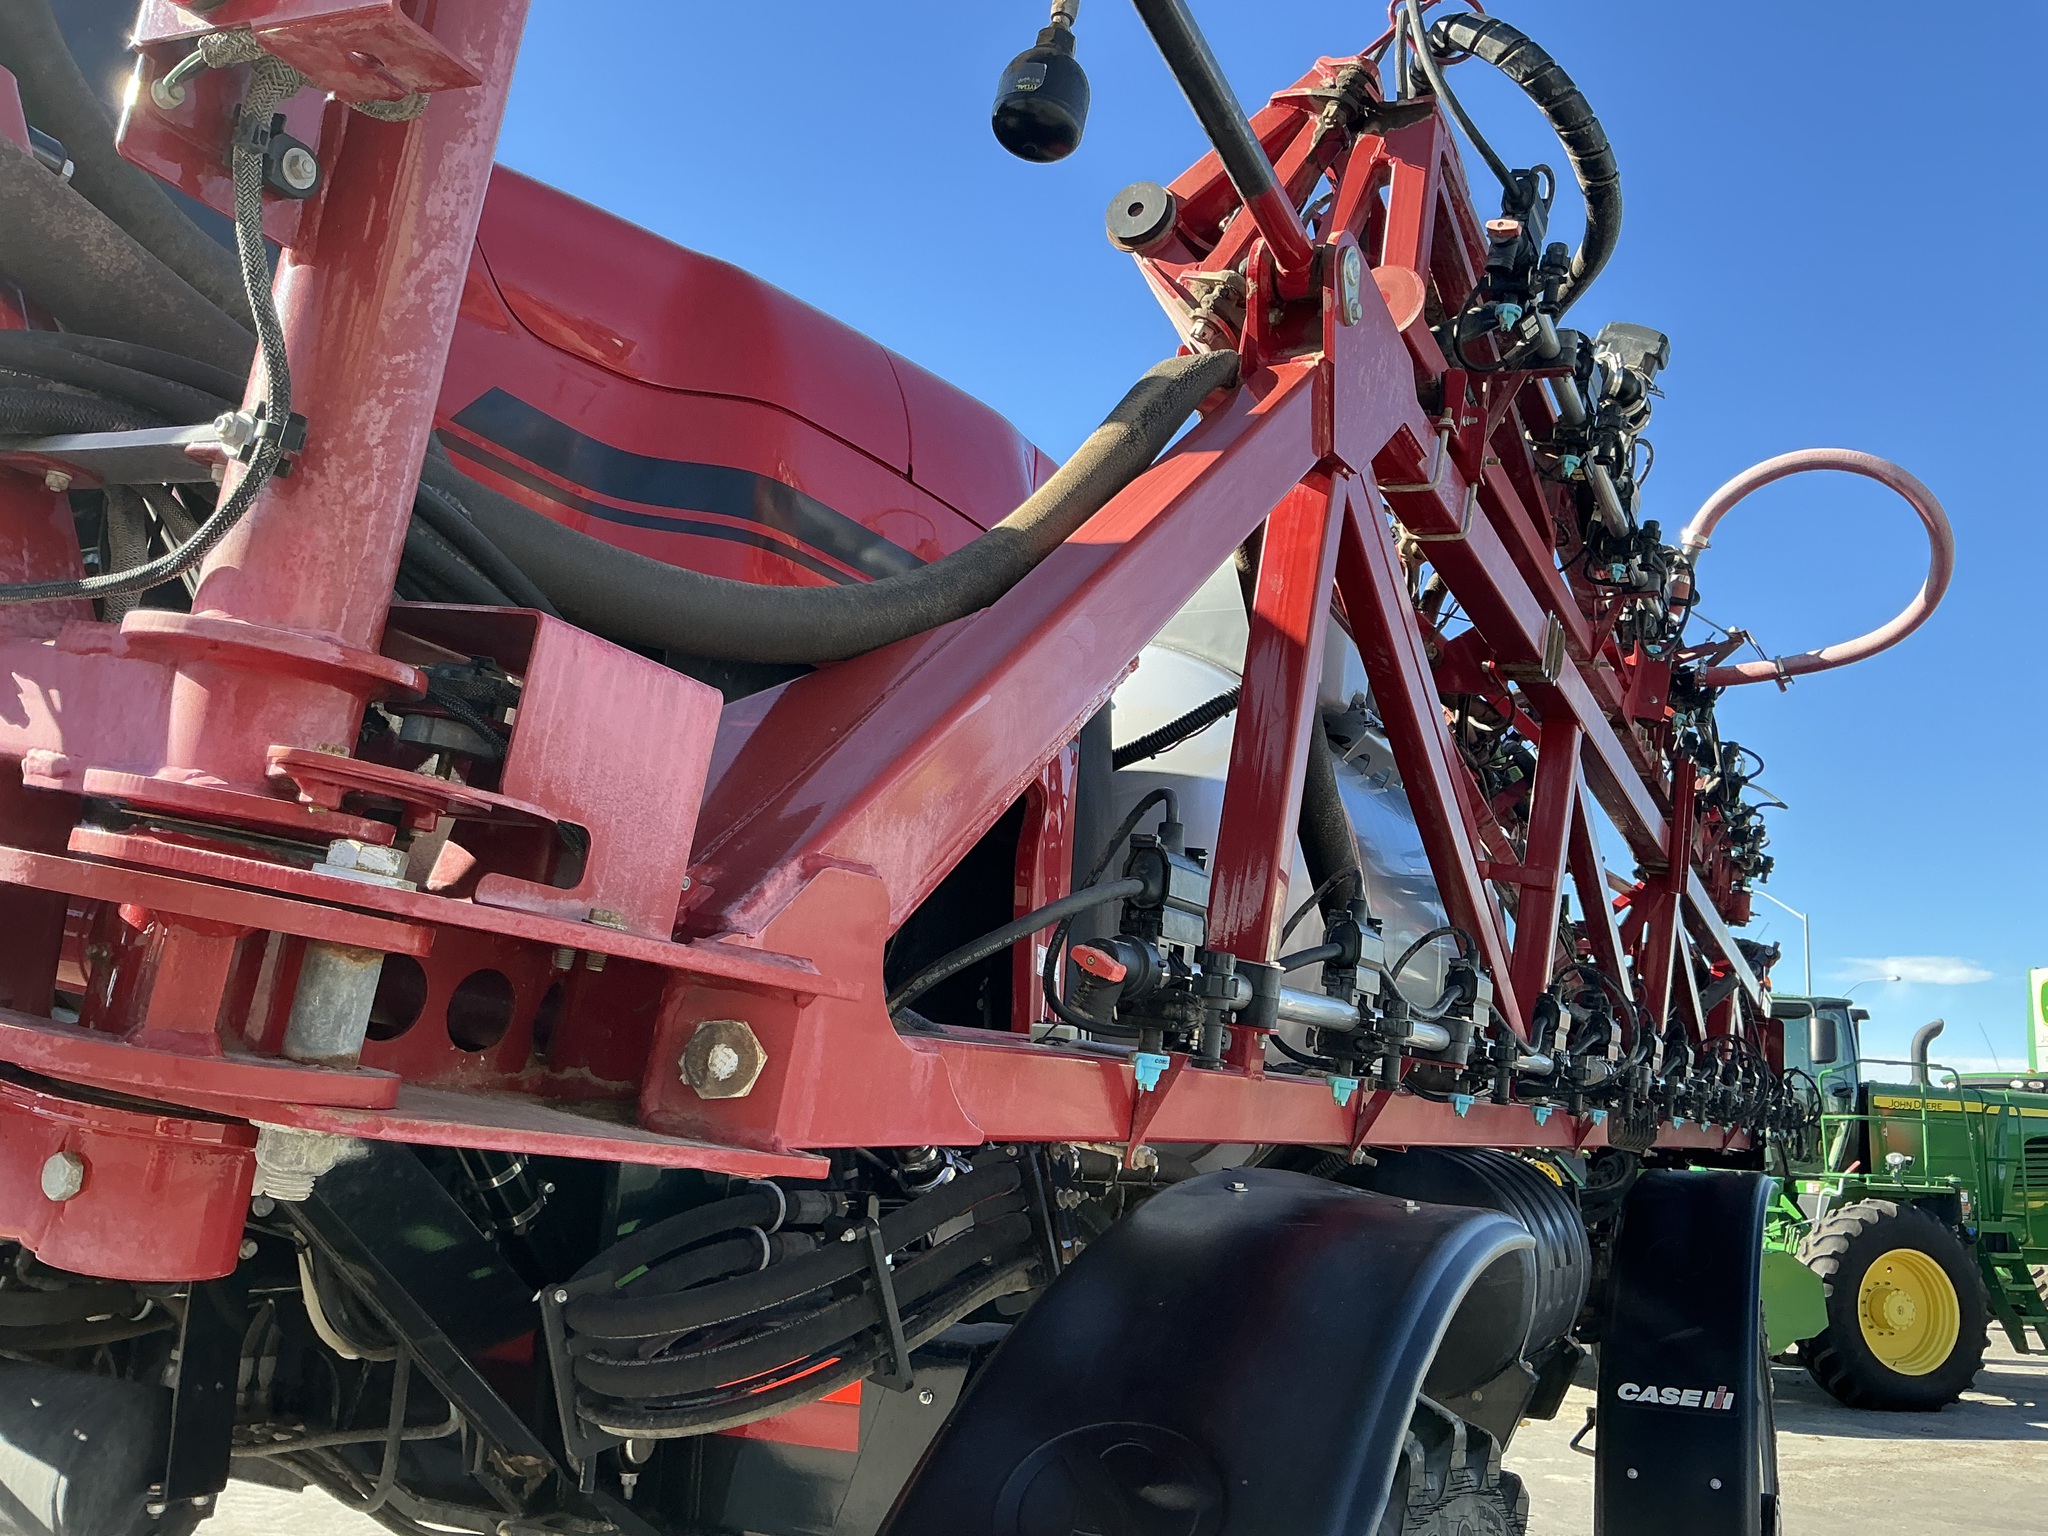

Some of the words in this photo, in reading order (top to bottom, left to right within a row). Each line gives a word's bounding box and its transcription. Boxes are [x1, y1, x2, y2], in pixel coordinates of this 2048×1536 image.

[973, 941, 1002, 958] RESISTANT
[1004, 937, 1012, 945] OR
[1889, 1099, 1912, 1108] JOHN
[1914, 1100, 1942, 1110] DERE
[1617, 1382, 1703, 1408] CASE
